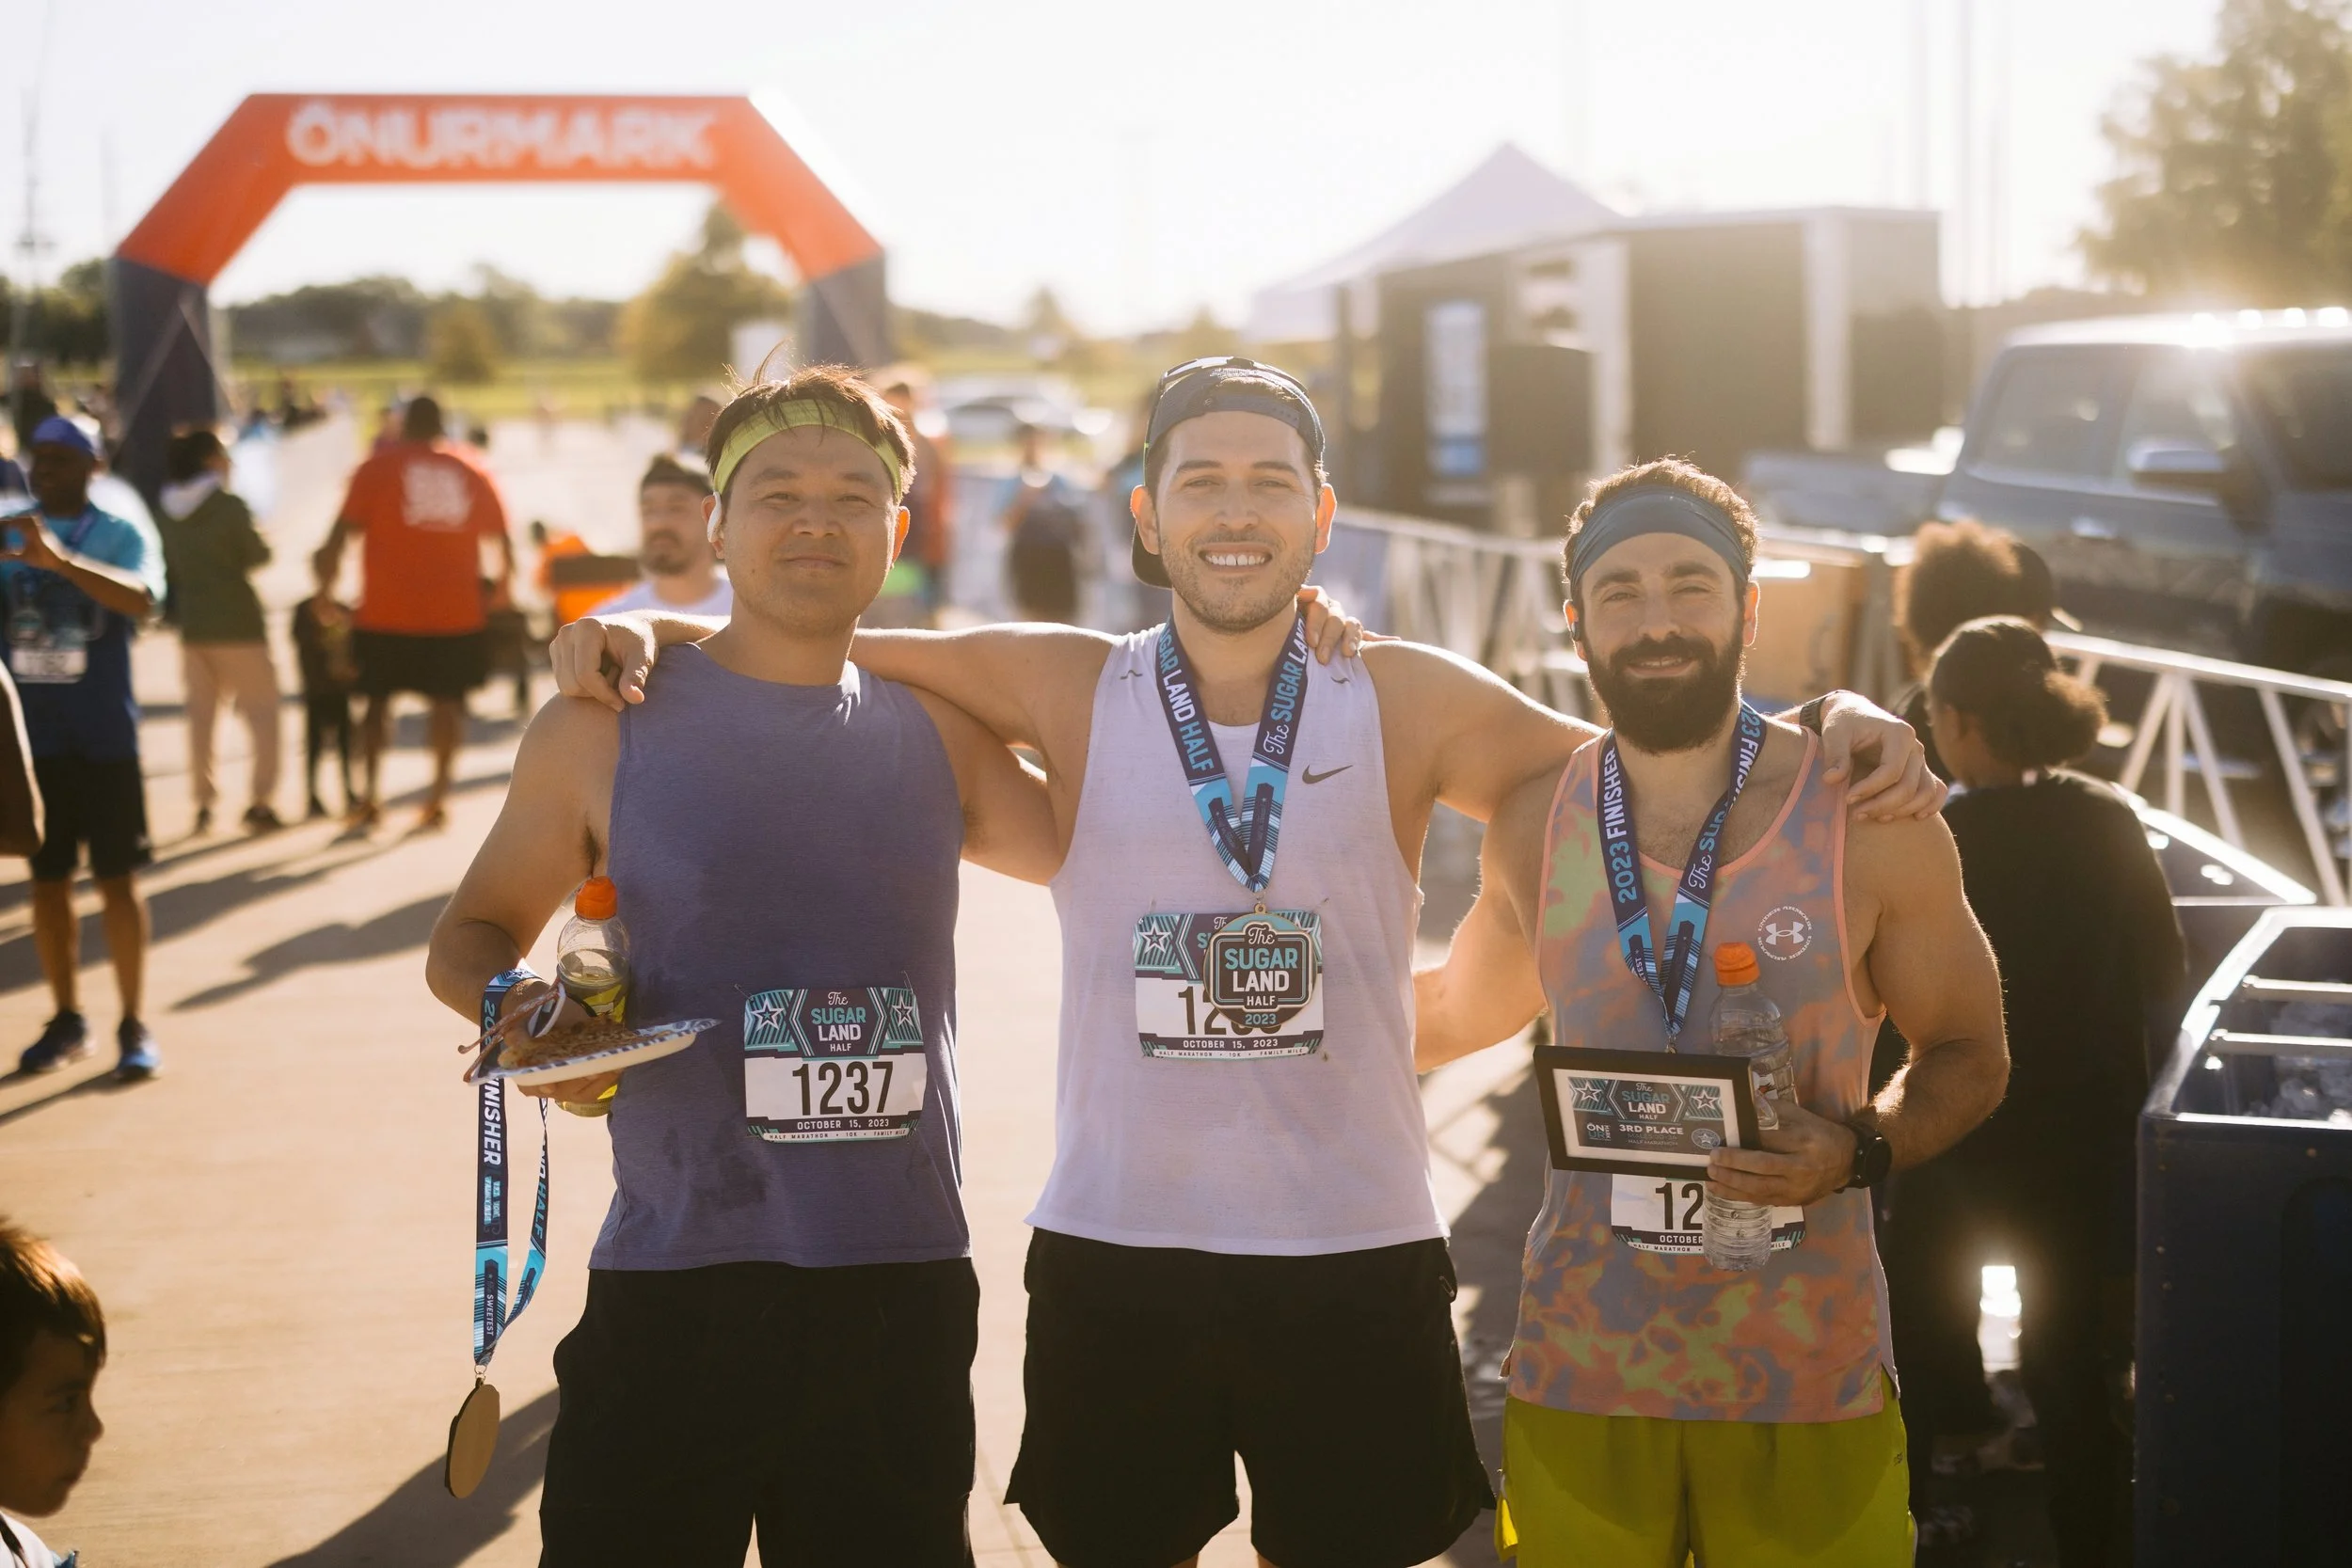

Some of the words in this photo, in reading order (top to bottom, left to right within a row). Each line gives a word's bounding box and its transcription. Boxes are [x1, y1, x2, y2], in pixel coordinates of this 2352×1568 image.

[1163, 669, 1196, 723] LAND
[1271, 661, 1304, 723] SUGAR
[1179, 721, 1215, 772] HALF
[1263, 724, 1290, 754] The
[1604, 746, 1628, 840] FINISHER
[1699, 802, 1728, 852] SUG
[1610, 841, 1636, 904] 2023
[1688, 854, 1712, 889] The
[1248, 927, 1275, 945] The
[1225, 947, 1298, 970] SUGAR
[1232, 971, 1290, 992] LAND
[828, 991, 849, 1006] The
[1247, 995, 1276, 1006] HALF
[811, 1006, 866, 1025] SUGAR
[1245, 1013, 1277, 1025] 2023
[818, 1024, 862, 1042] LAND
[830, 1043, 851, 1053] HALF
[1184, 1039, 1225, 1049] OCTOBER
[1232, 1040, 1246, 1050] 15,
[1253, 1038, 1279, 1048] 2023
[792, 1061, 894, 1117] 1237
[1621, 1091, 1670, 1104] SUGAR
[1628, 1101, 1667, 1115] LAND
[484, 1078, 501, 1165] INISHER
[797, 1120, 842, 1130] OCTOBER
[849, 1119, 862, 1129] 15,
[868, 1119, 889, 1128] 2023
[1619, 1124, 1643, 1133] 3RD
[1647, 1126, 1684, 1135] PLACE
[1655, 1182, 1704, 1231] 12
